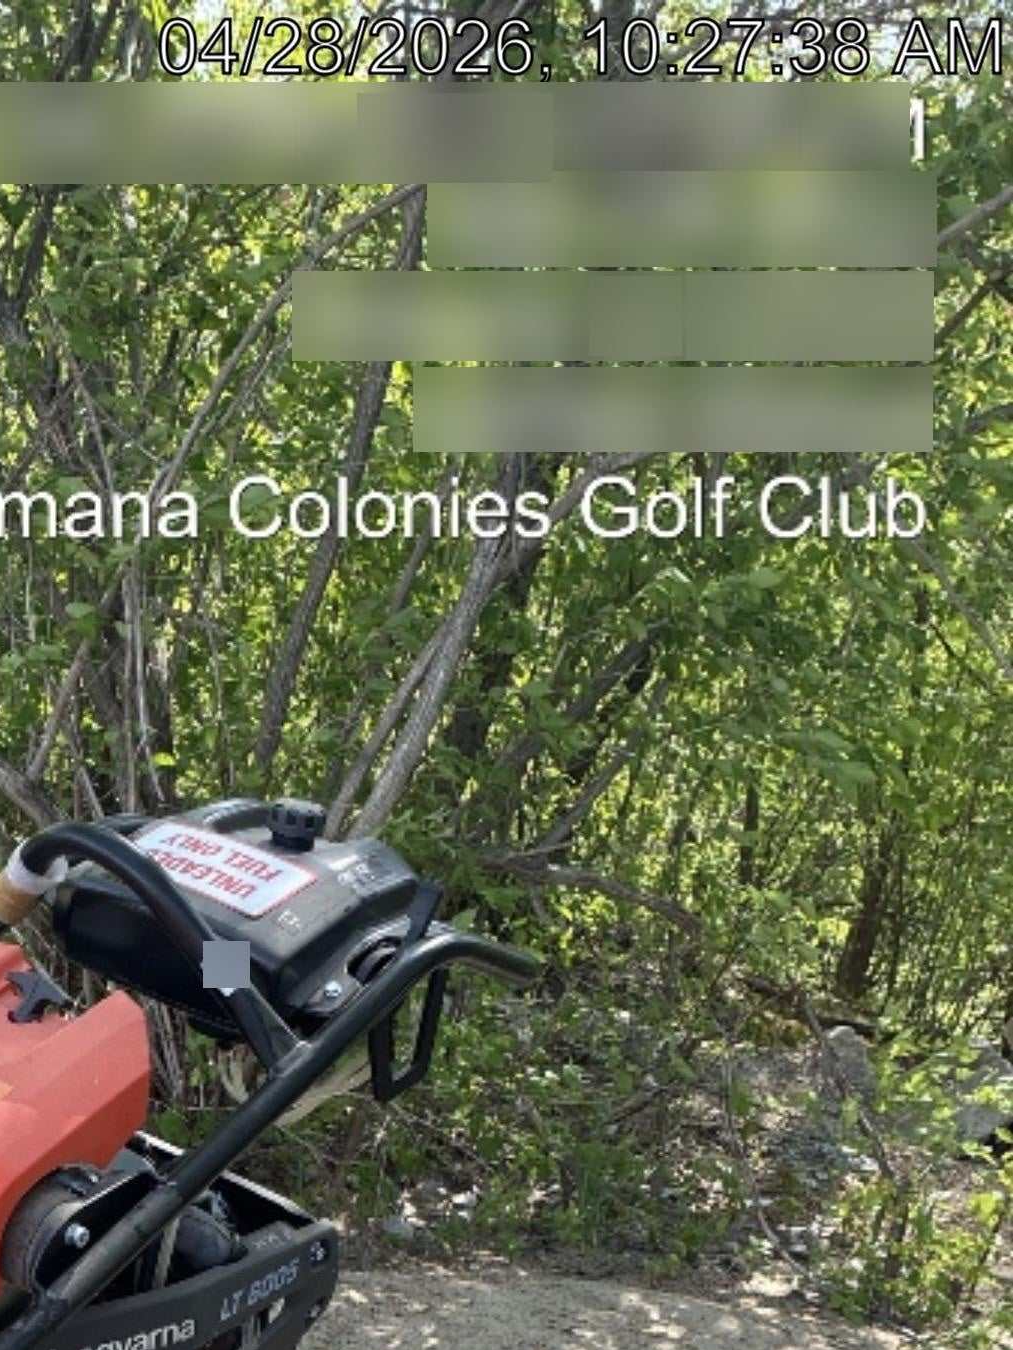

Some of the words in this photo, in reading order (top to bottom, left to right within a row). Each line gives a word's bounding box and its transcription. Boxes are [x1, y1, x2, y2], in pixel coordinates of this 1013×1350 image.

[160, 834, 223, 858] ONLY
[147, 849, 258, 899] UNLEADE
[223, 850, 284, 882] FUEL
